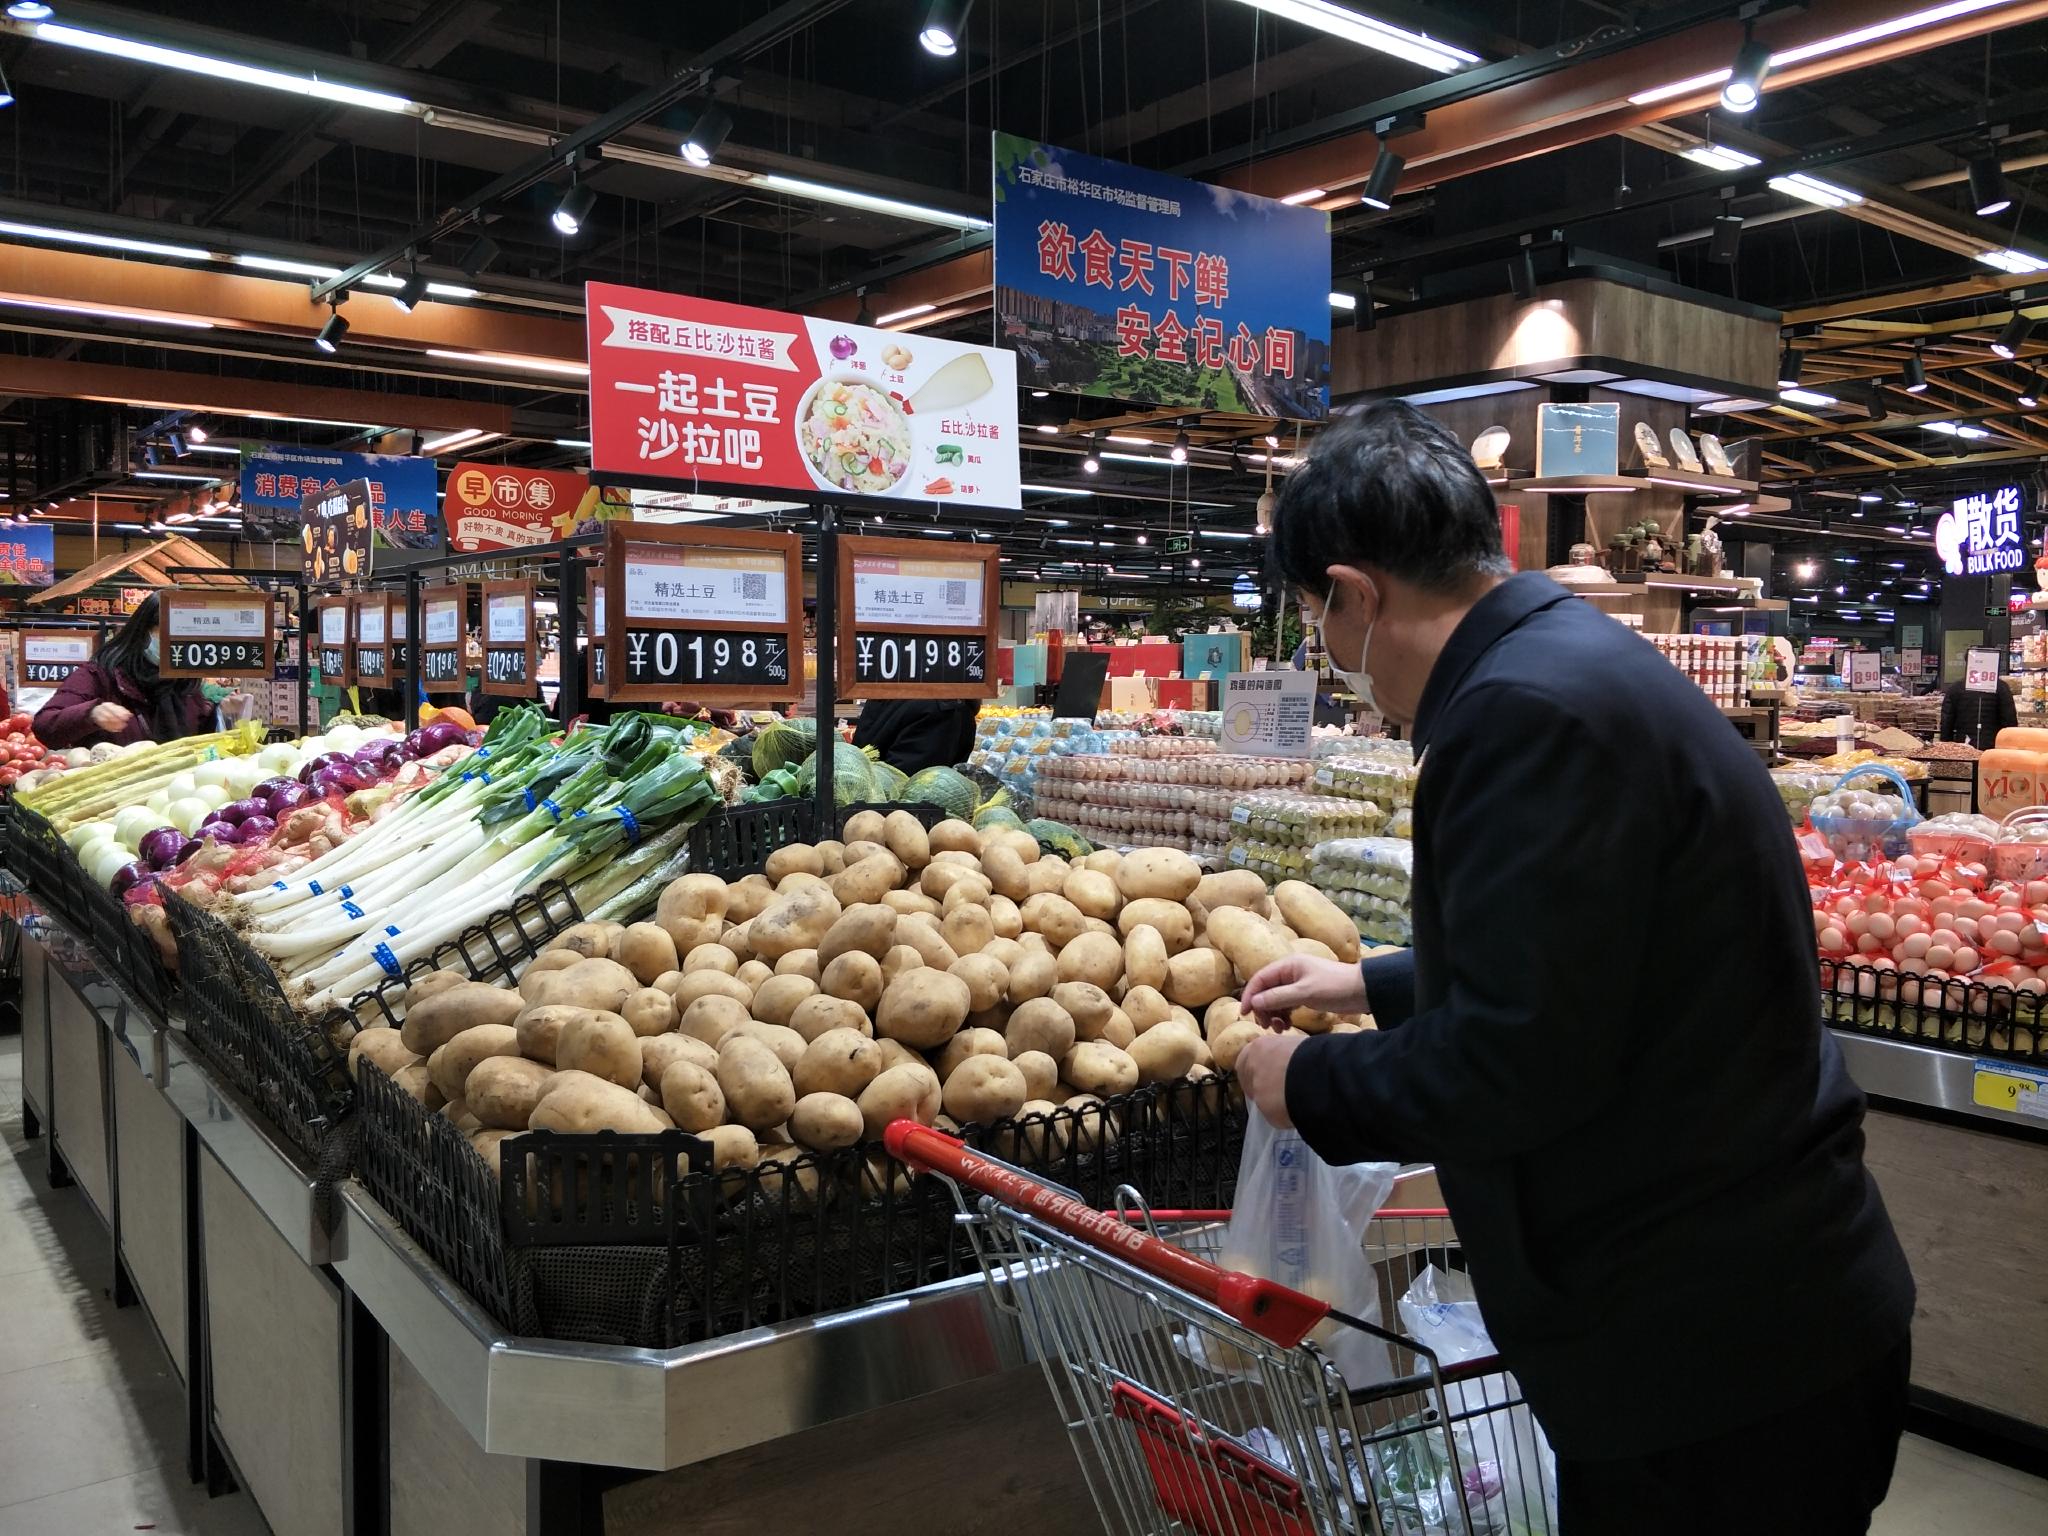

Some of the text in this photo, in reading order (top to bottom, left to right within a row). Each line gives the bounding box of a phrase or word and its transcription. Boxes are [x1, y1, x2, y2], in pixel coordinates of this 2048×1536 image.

[1018, 166, 1181, 218] 石家庄市裕华区市场监督管理局
[1038, 220, 1229, 309] 欲食天下鲜
[1116, 303, 1295, 379] 安全记心间
[614, 370, 781, 424] 一起土豆
[637, 416, 763, 470] 沙拉吧
[941, 420, 999, 439] 丘比沙拉酱
[255, 473, 386, 504] 消费安品
[463, 475, 551, 507] 早市集
[463, 507, 543, 521] GOOD MORING
[463, 521, 504, 537] 好物不贵
[1967, 488, 2020, 552] 散货
[1967, 549, 2023, 574] BULK FOOD
[654, 580, 716, 599] 精选土豆
[874, 589, 925, 605] 精选土豆
[170, 643, 246, 667] ¥03.99
[626, 632, 758, 679] ¥01.98
[856, 637, 961, 680] ¥01.98
